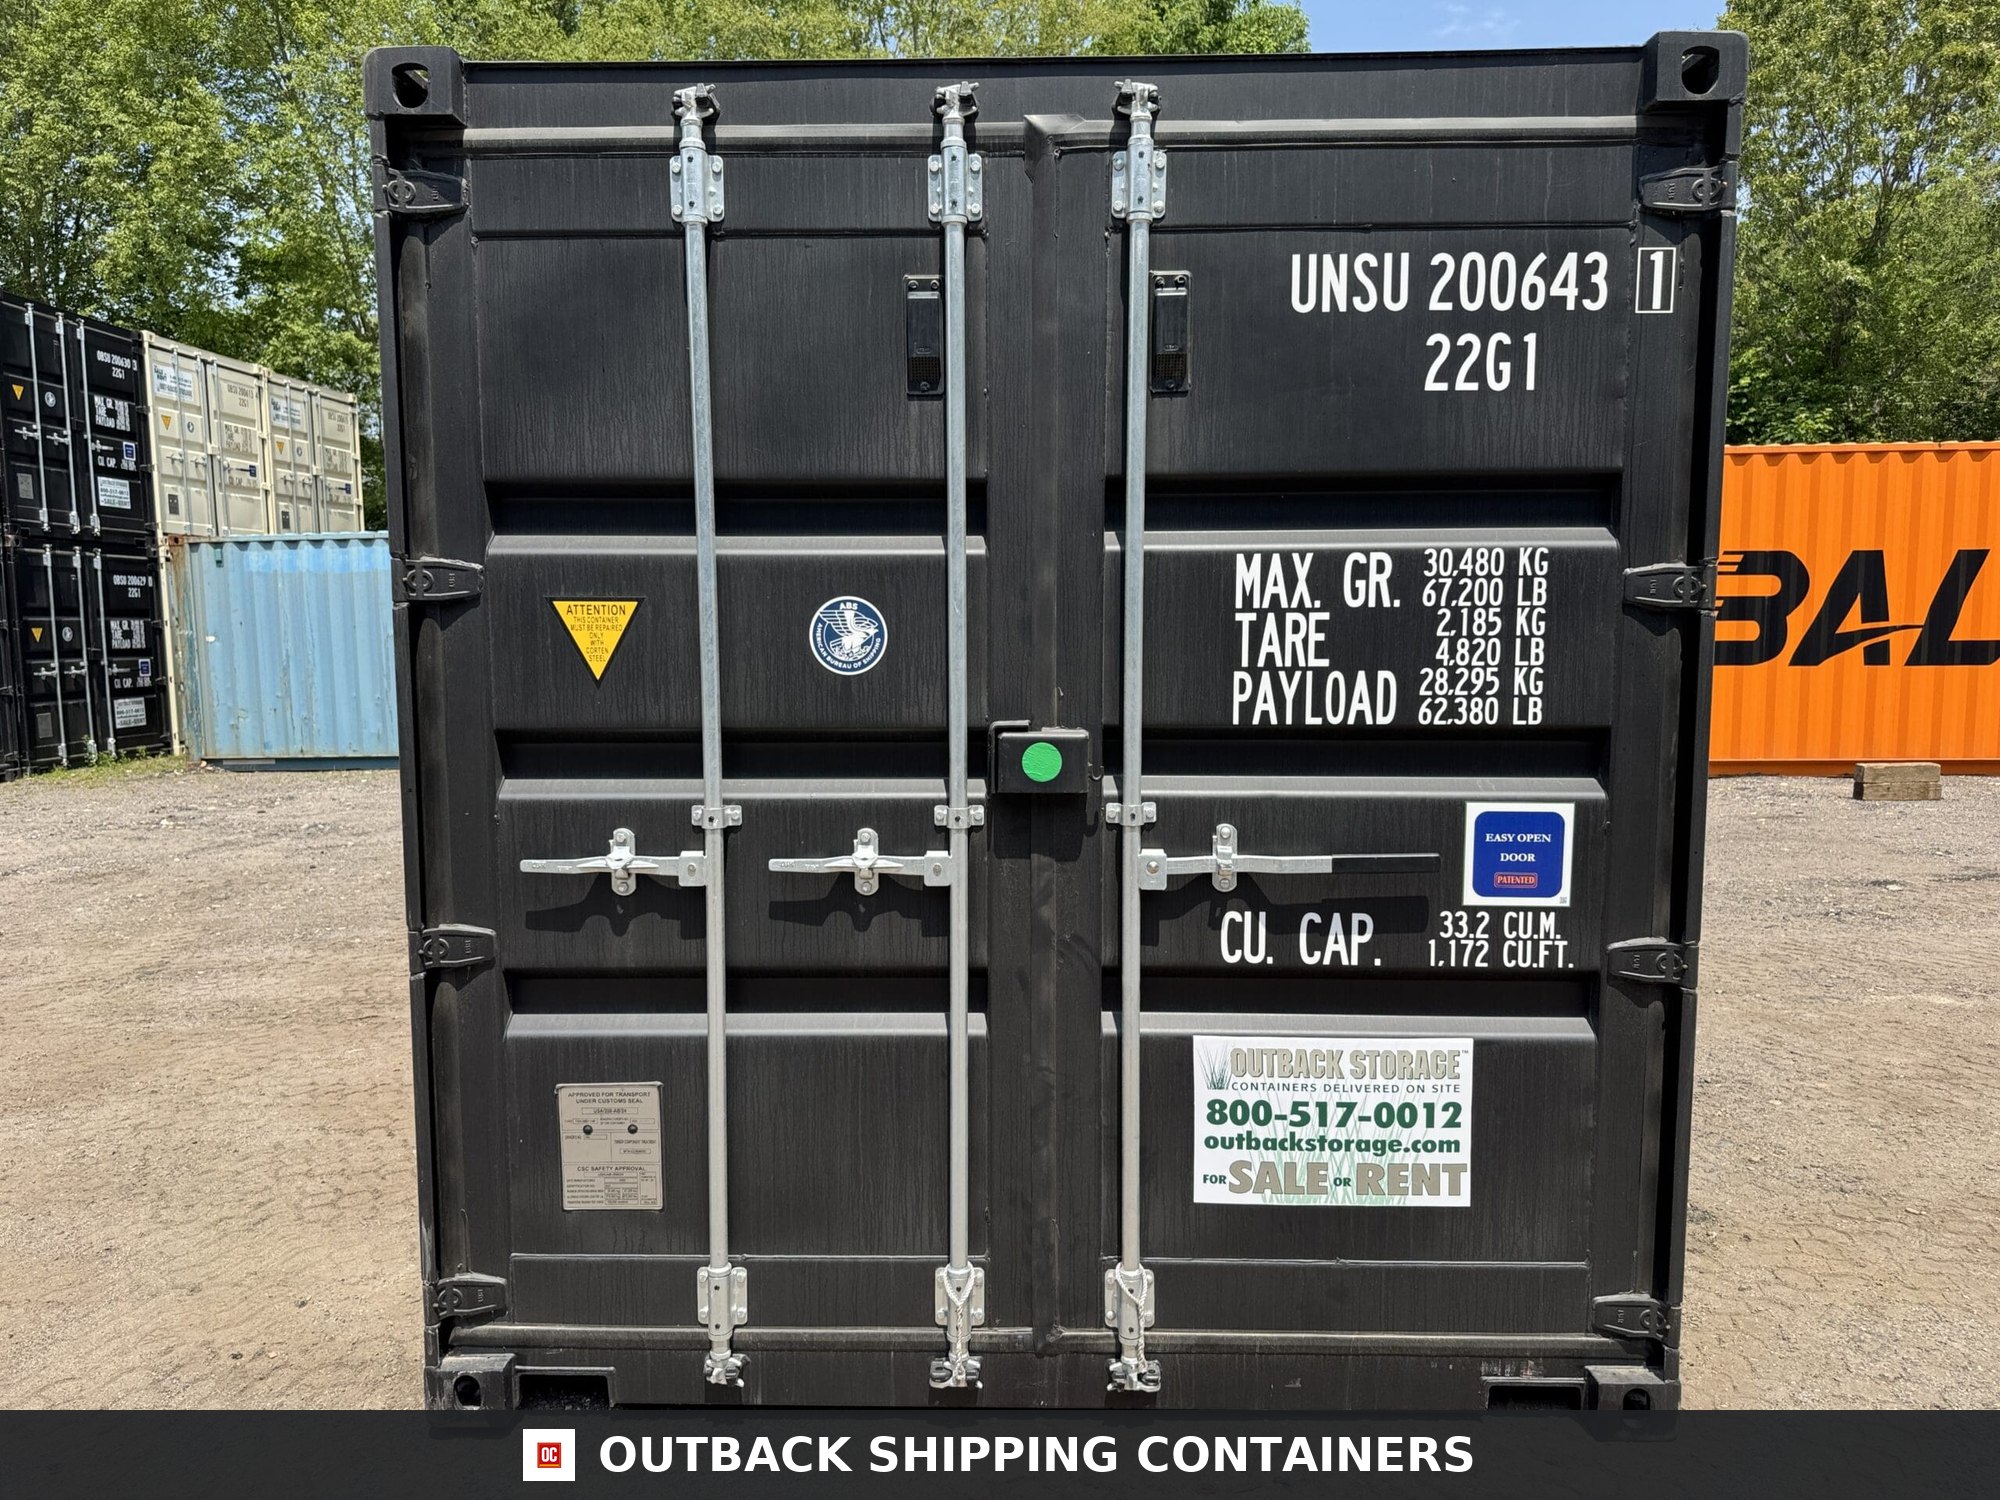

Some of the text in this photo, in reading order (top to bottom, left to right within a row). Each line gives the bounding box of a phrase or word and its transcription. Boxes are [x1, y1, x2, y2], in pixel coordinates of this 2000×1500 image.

[1291, 252, 1410, 313] UNSU
[1428, 250, 1609, 312] 200643
[1424, 332, 1538, 392] 22G1
[1234, 547, 1549, 609] MAX. GR. 30,480 KG
[1422, 578, 1547, 607] 67,200 LB
[566, 604, 626, 616] ATTENTION
[839, 602, 859, 610] ABS
[815, 622, 827, 658] AMERICAN
[826, 655, 852, 669] BUREAU
[862, 637, 882, 665] SHIPPING
[1234, 607, 1546, 667] TARE 2,185 KG
[1435, 638, 1545, 667] 4,820 LB
[1232, 667, 1544, 726] PAYLOAD 28,295 KG
[1417, 697, 1543, 726] 62,380 LB
[1485, 833, 1552, 843] EASY OPEN
[1500, 853, 1536, 862] DOOR
[1497, 875, 1536, 885] PATENTED
[1220, 911, 1561, 966] CU. CAP. 33.2 CU.M.
[1428, 939, 1574, 969] 1,172 CU.FT.
[1230, 1047, 1344, 1079] OUTBACK
[1231, 1081, 1461, 1093] CONTAINERS DELIVERED ON SITE
[1206, 1098, 1462, 1129] 800-517-0012
[1204, 1131, 1461, 1156] outbackstorage.com
[1203, 1160, 1468, 1196] FOR SALE OR RENT
